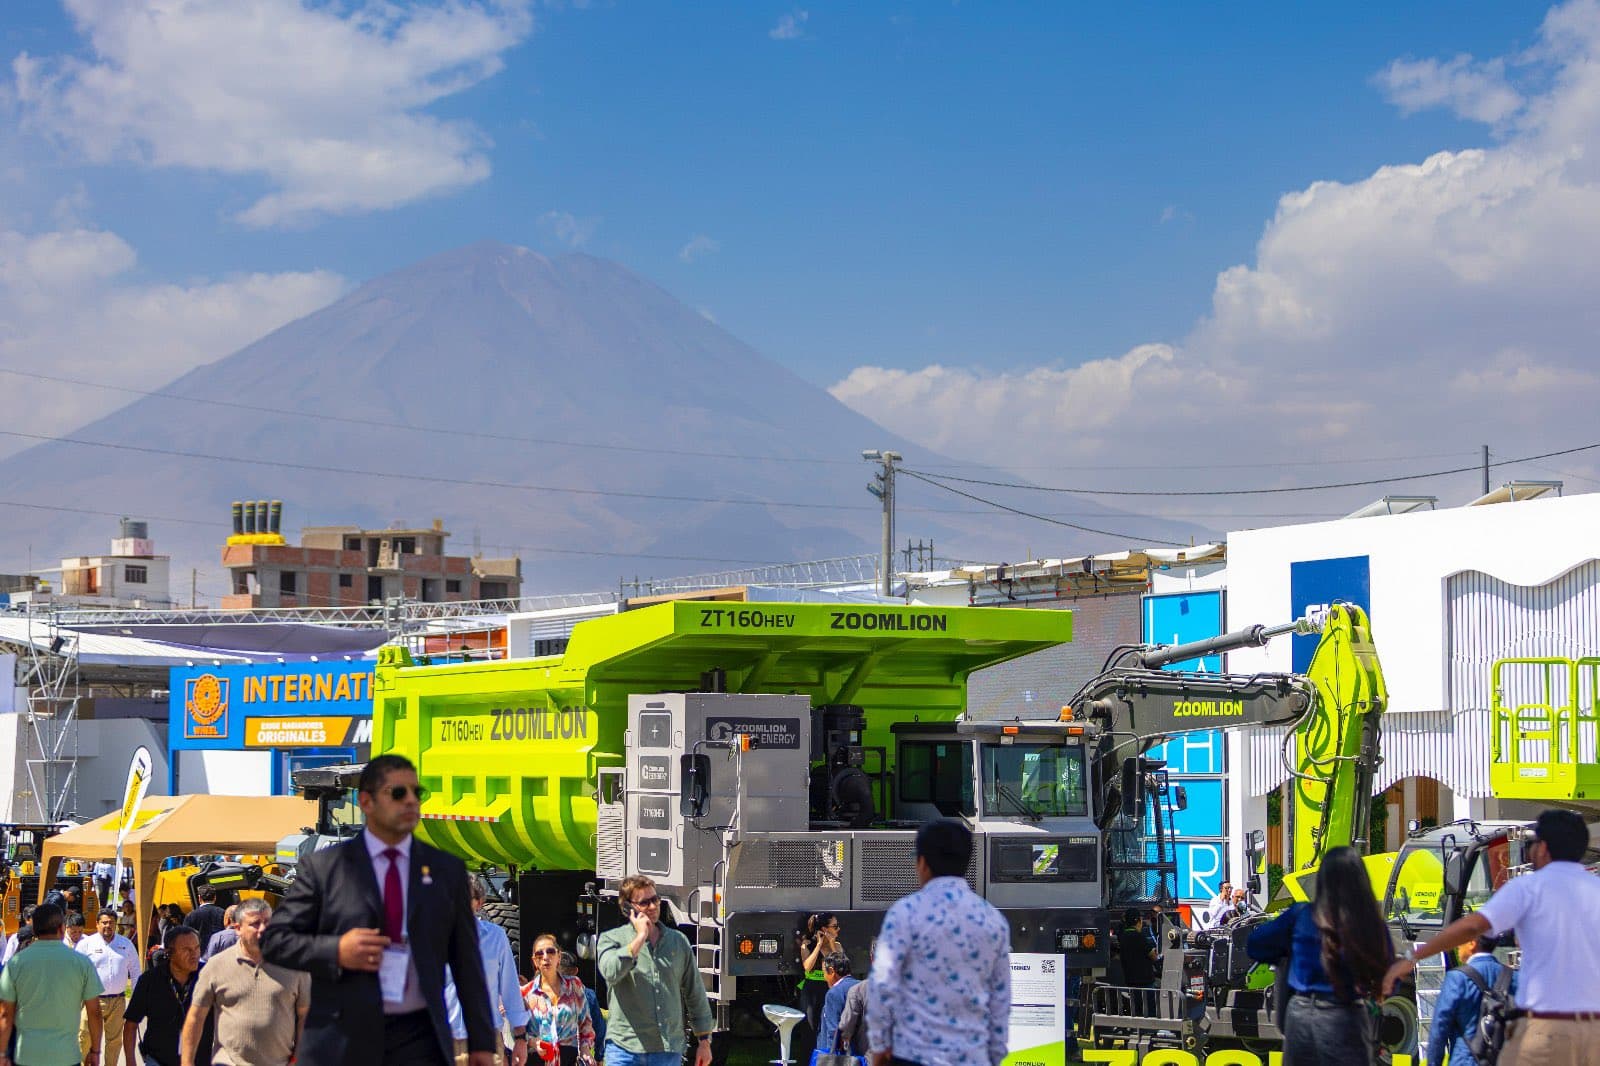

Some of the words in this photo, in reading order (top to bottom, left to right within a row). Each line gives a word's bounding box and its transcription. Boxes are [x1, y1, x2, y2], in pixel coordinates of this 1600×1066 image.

[700, 609, 795, 628] ZT160HEV
[830, 612, 947, 632] ZOOMLION
[1173, 700, 1243, 717] ZOOMLION
[440, 719, 484, 742] ZT160HEV
[490, 705, 588, 741] ZOOMLION
[734, 724, 787, 733] ZOOMLION
[257, 730, 326, 743] ORIGINALES
[761, 733, 796, 744] ENERGY
